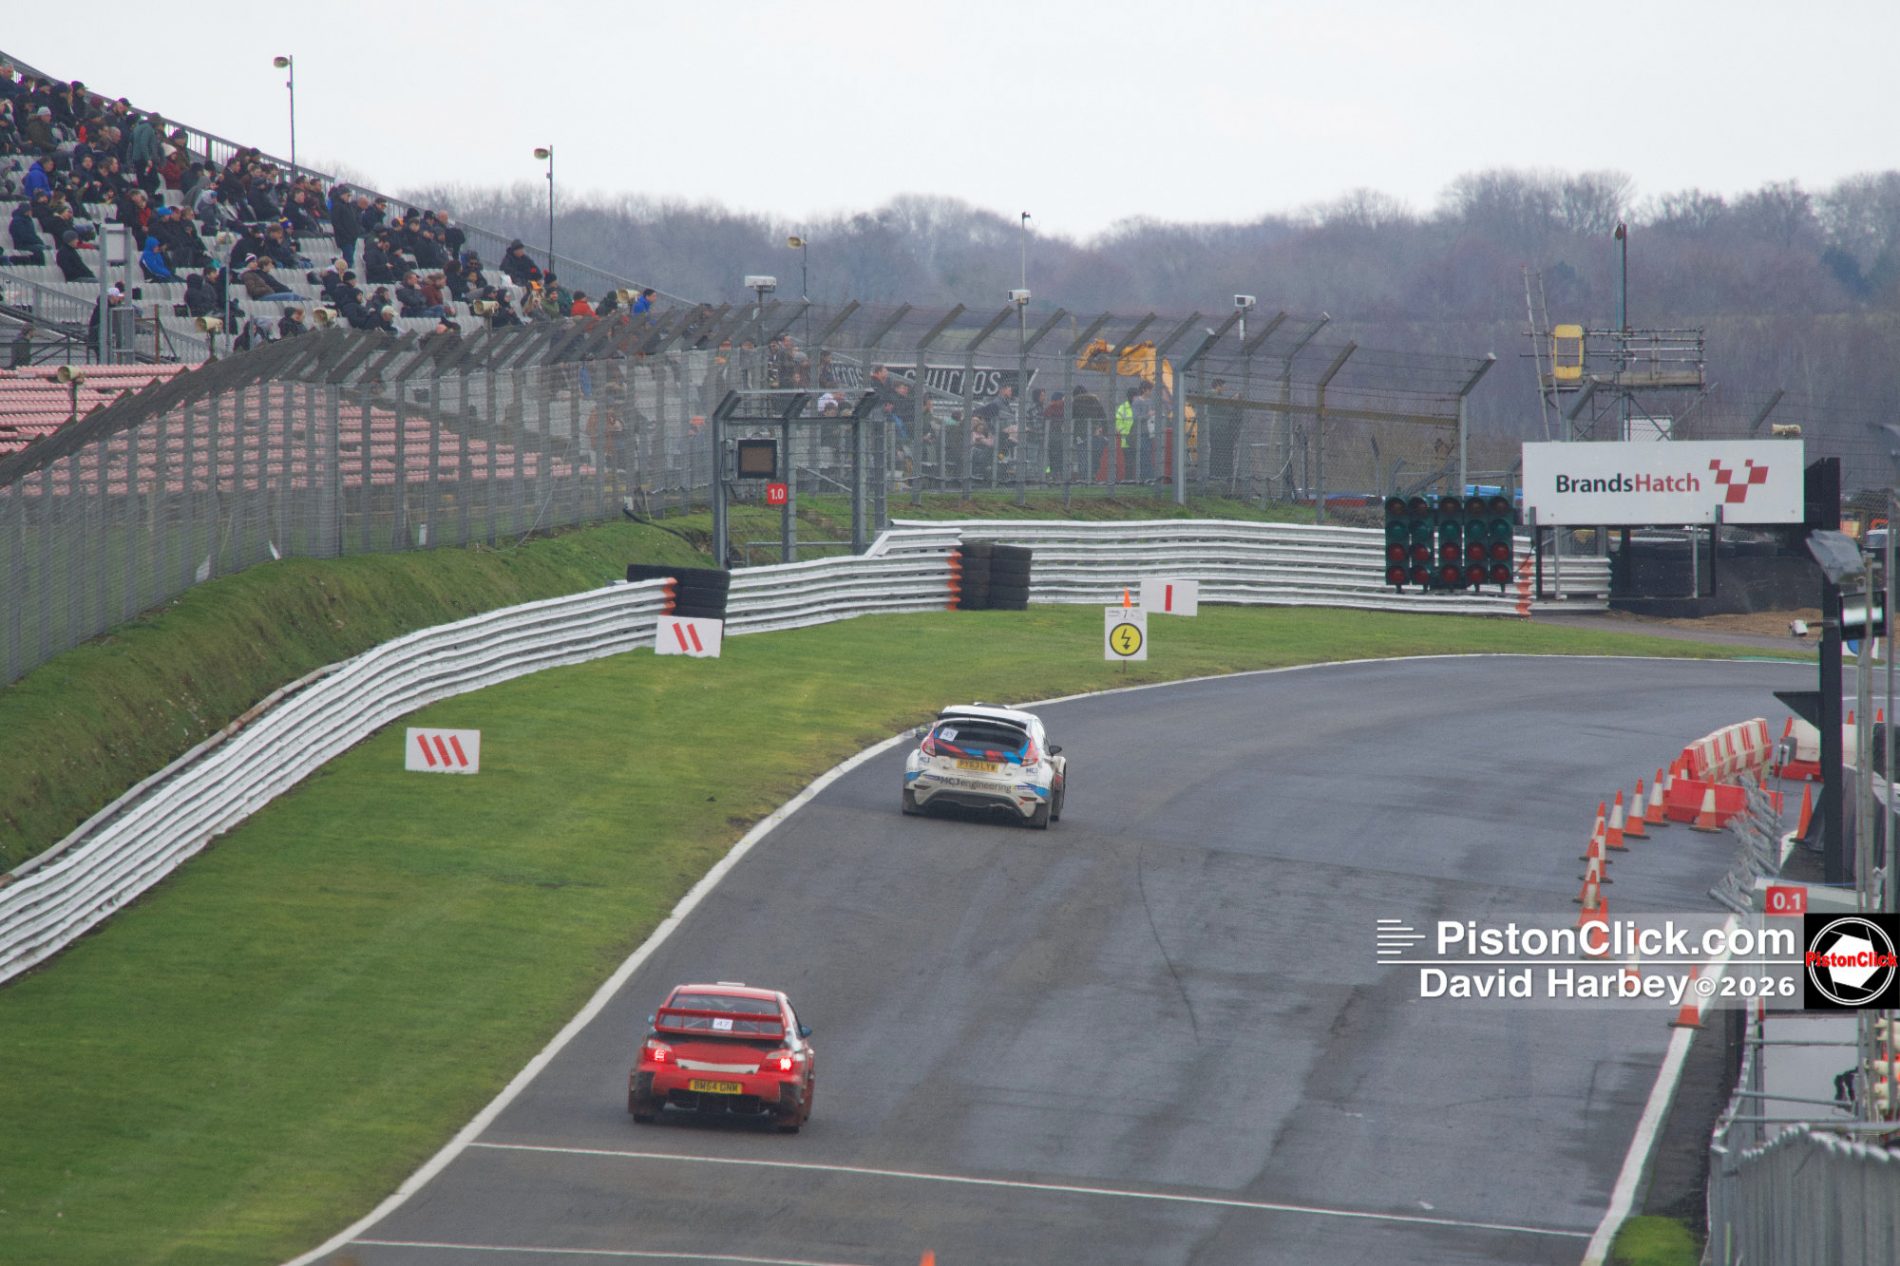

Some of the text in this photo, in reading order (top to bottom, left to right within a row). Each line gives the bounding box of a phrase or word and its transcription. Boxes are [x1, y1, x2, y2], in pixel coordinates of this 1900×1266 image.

[1556, 473, 1700, 493] BrandsHatch
[770, 488, 784, 500] 1.0
[1772, 893, 1803, 910] 0.1
